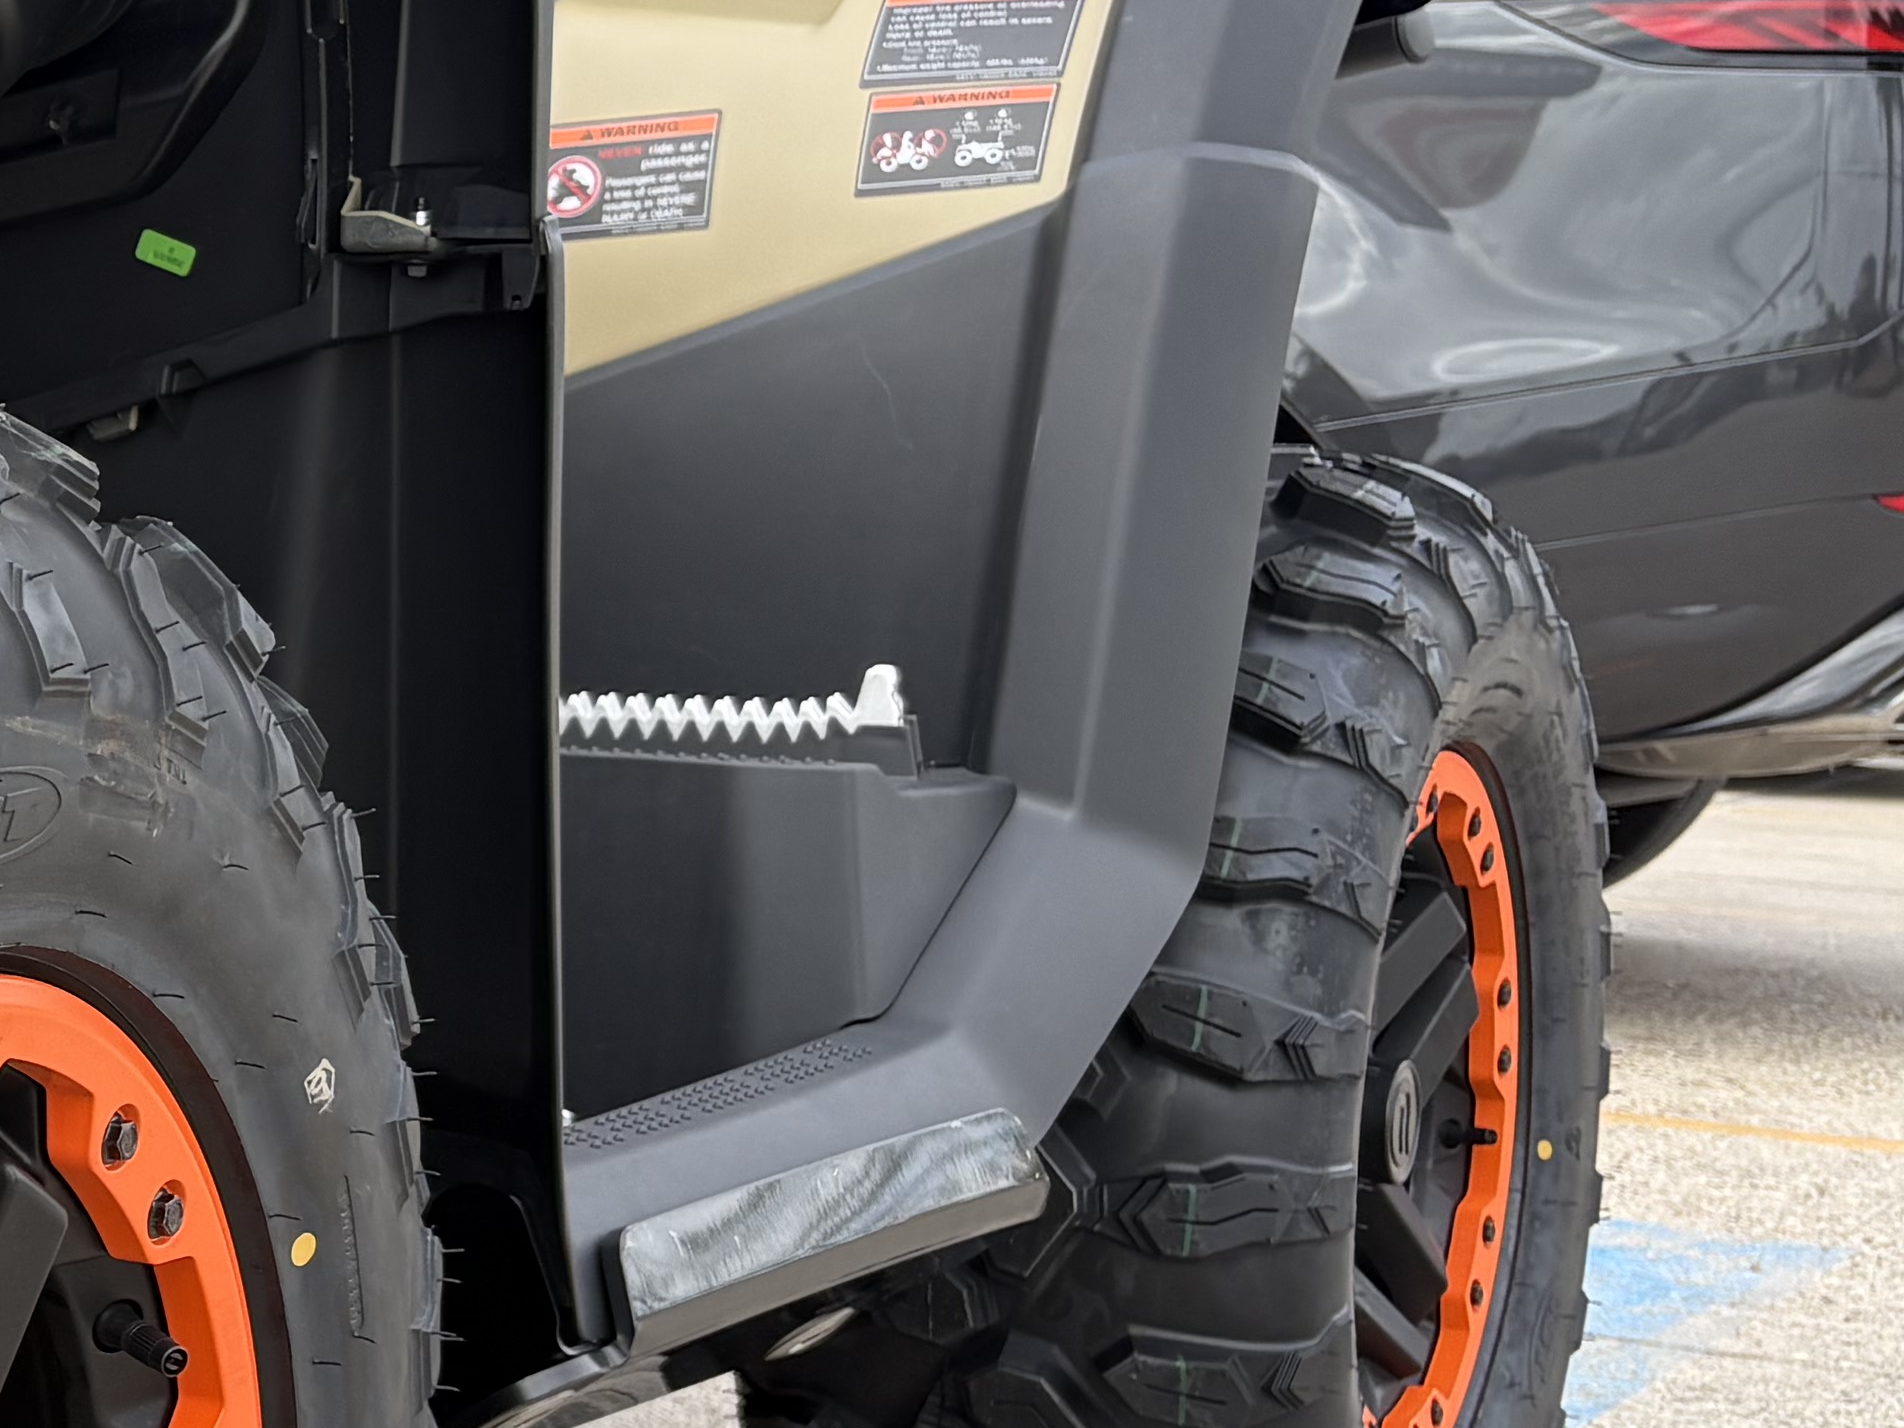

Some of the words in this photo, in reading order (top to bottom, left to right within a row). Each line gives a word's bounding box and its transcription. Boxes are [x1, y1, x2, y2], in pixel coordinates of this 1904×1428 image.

[932, 90, 1011, 104] WARNING
[600, 121, 679, 139] WARNING
[648, 142, 674, 155] ride
[679, 141, 694, 152] as
[640, 154, 707, 172] passenger
